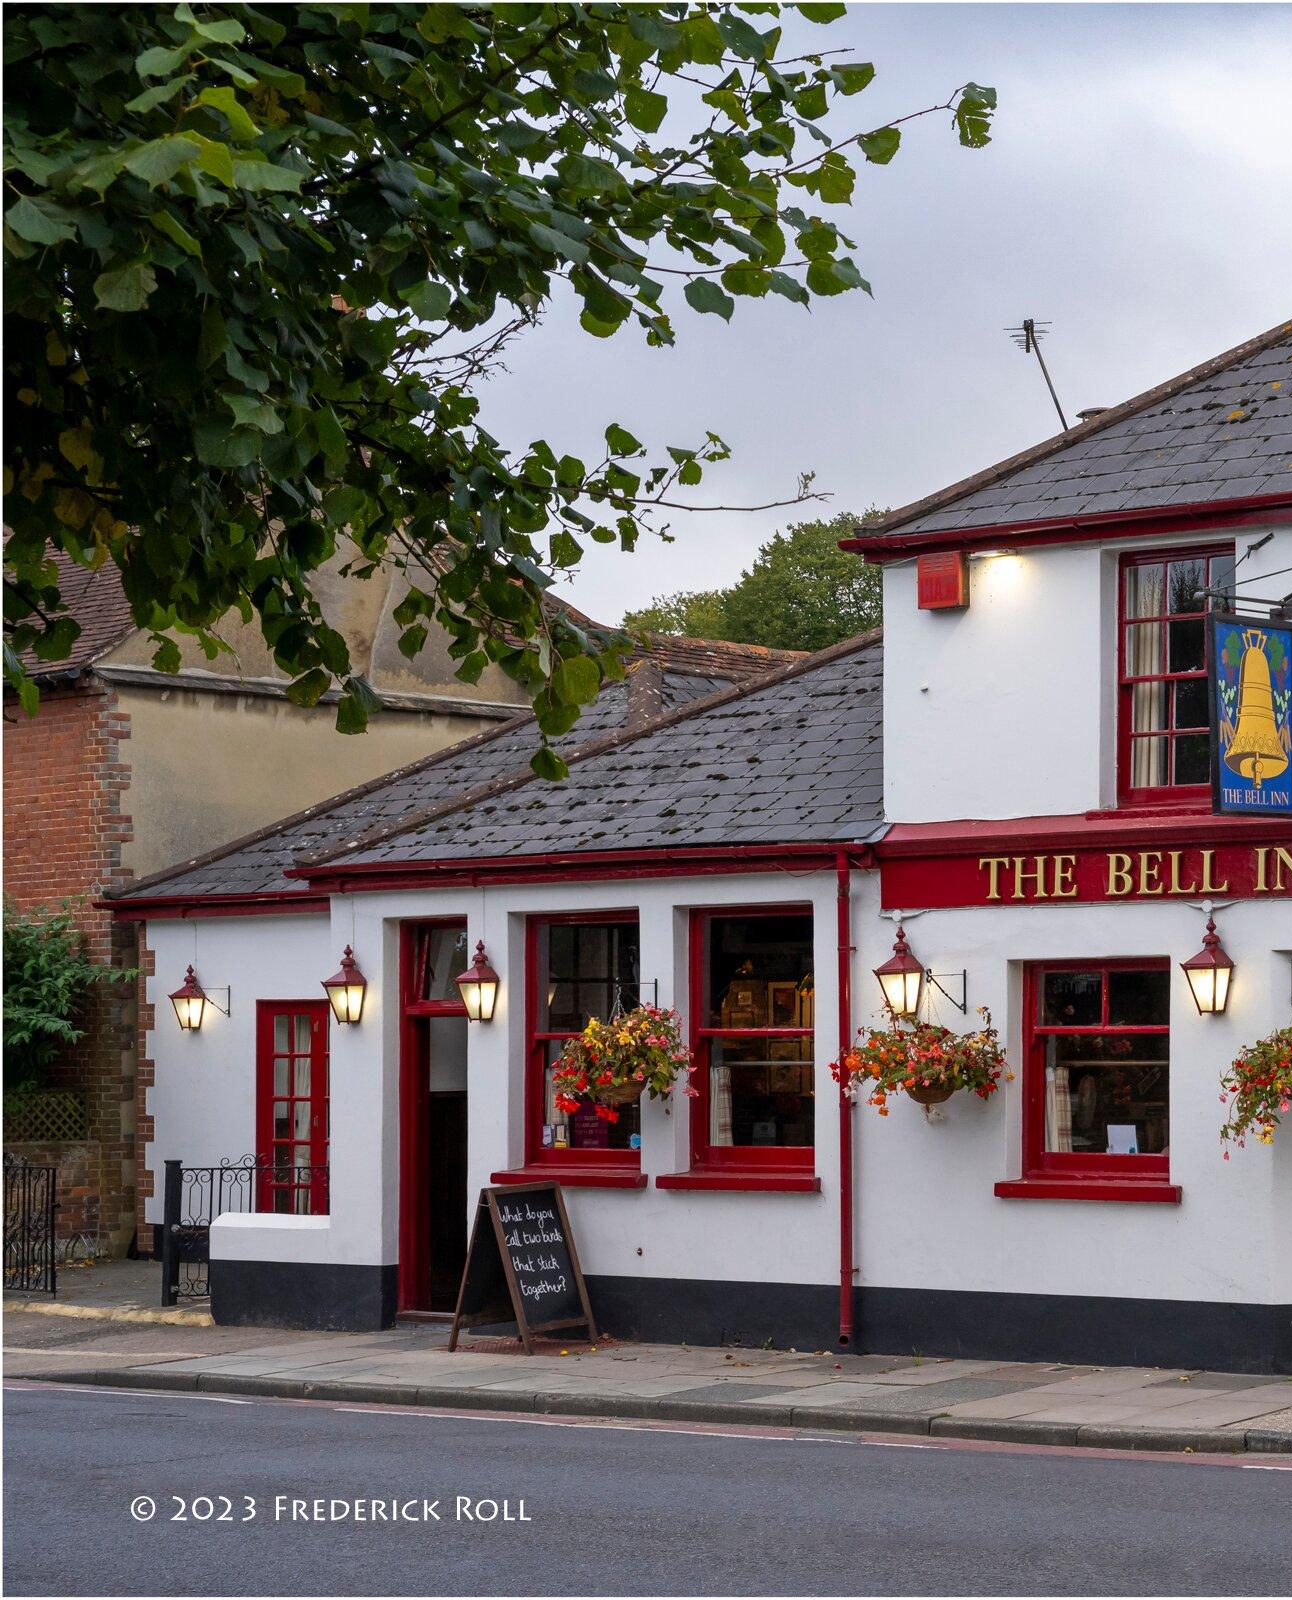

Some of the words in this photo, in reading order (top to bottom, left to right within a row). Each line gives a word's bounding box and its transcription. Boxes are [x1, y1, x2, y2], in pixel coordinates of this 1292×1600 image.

[1223, 788, 1242, 804] THE
[1245, 790, 1269, 805] BELL
[1271, 791, 1289, 806] INN
[979, 854, 1078, 899] THE
[1105, 851, 1229, 896] BELL
[526, 1203, 536, 1220] do
[536, 1208, 555, 1229] you
[522, 1231, 541, 1245] two
[541, 1228, 563, 1243] birds
[512, 1254, 535, 1272] that
[537, 1254, 560, 1271] stick
[520, 1275, 567, 1301] together?
